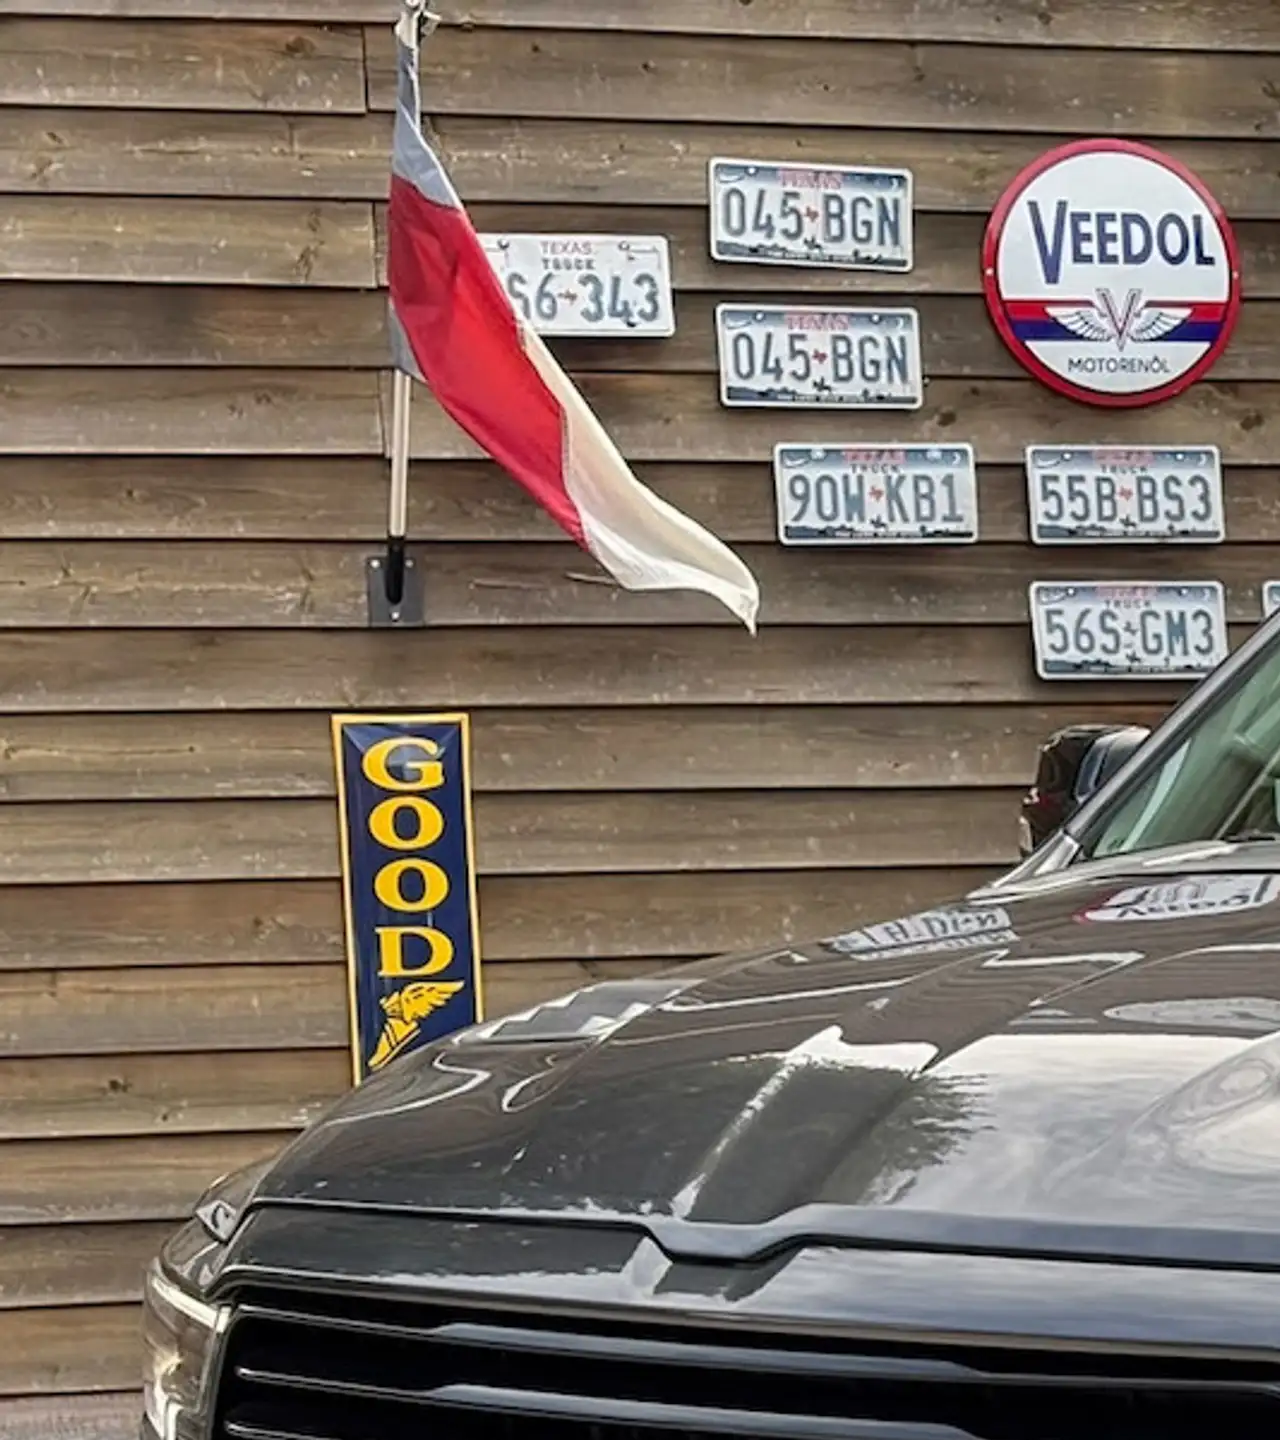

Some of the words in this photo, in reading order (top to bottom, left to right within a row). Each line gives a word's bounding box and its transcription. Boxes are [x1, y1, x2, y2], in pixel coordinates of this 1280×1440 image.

[540, 241, 594, 254] TEXAS
[1027, 200, 1215, 285] VEEDOL
[578, 273, 660, 322] 343
[361, 736, 455, 977] GOOD
